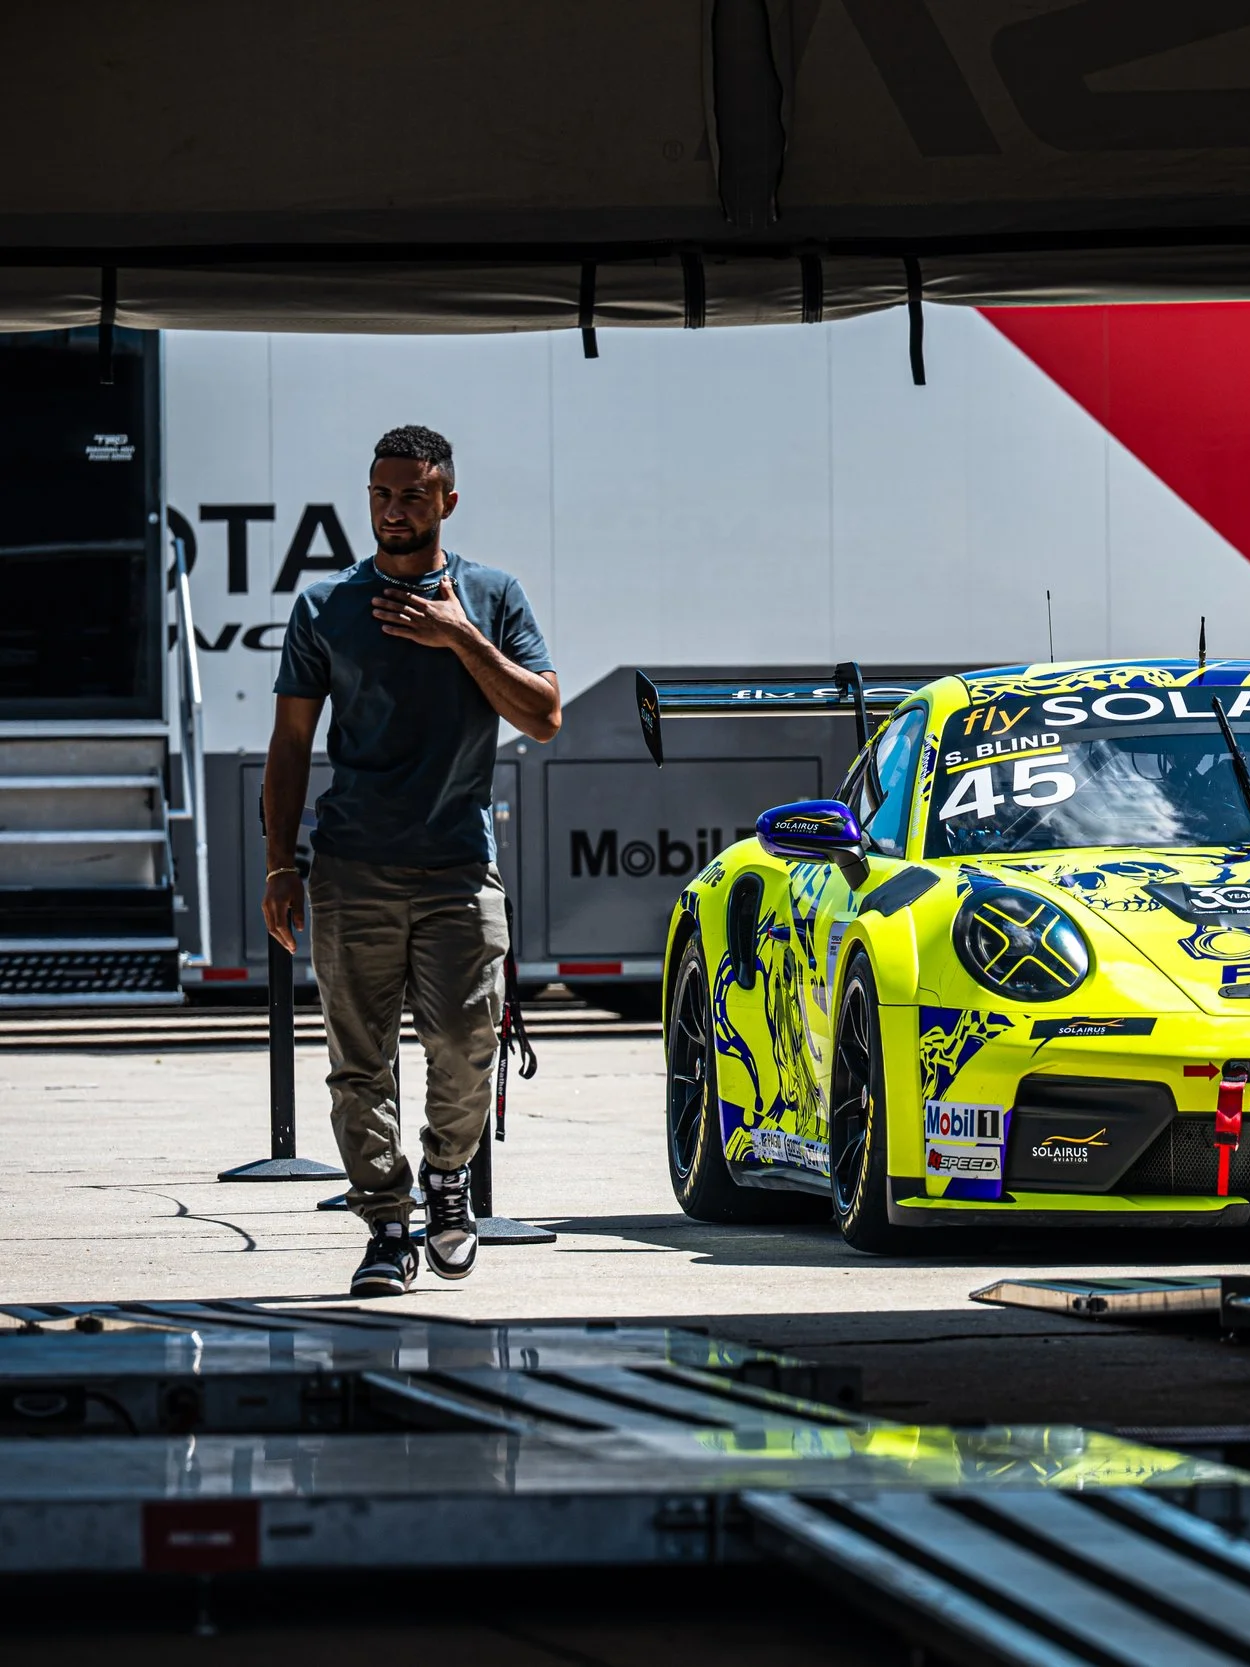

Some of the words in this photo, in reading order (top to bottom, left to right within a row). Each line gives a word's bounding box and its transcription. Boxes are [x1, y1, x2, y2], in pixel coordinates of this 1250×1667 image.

[963, 705, 1031, 736] fly
[945, 750, 968, 767] S.
[976, 733, 1060, 759] BLIND
[939, 754, 1076, 821] 45
[774, 821, 820, 831] SOLAIRUS
[1058, 1026, 1106, 1034] SOLAIRUS
[926, 1104, 975, 1138] Mobil
[1032, 1146, 1088, 1158] SOLAIRUS
